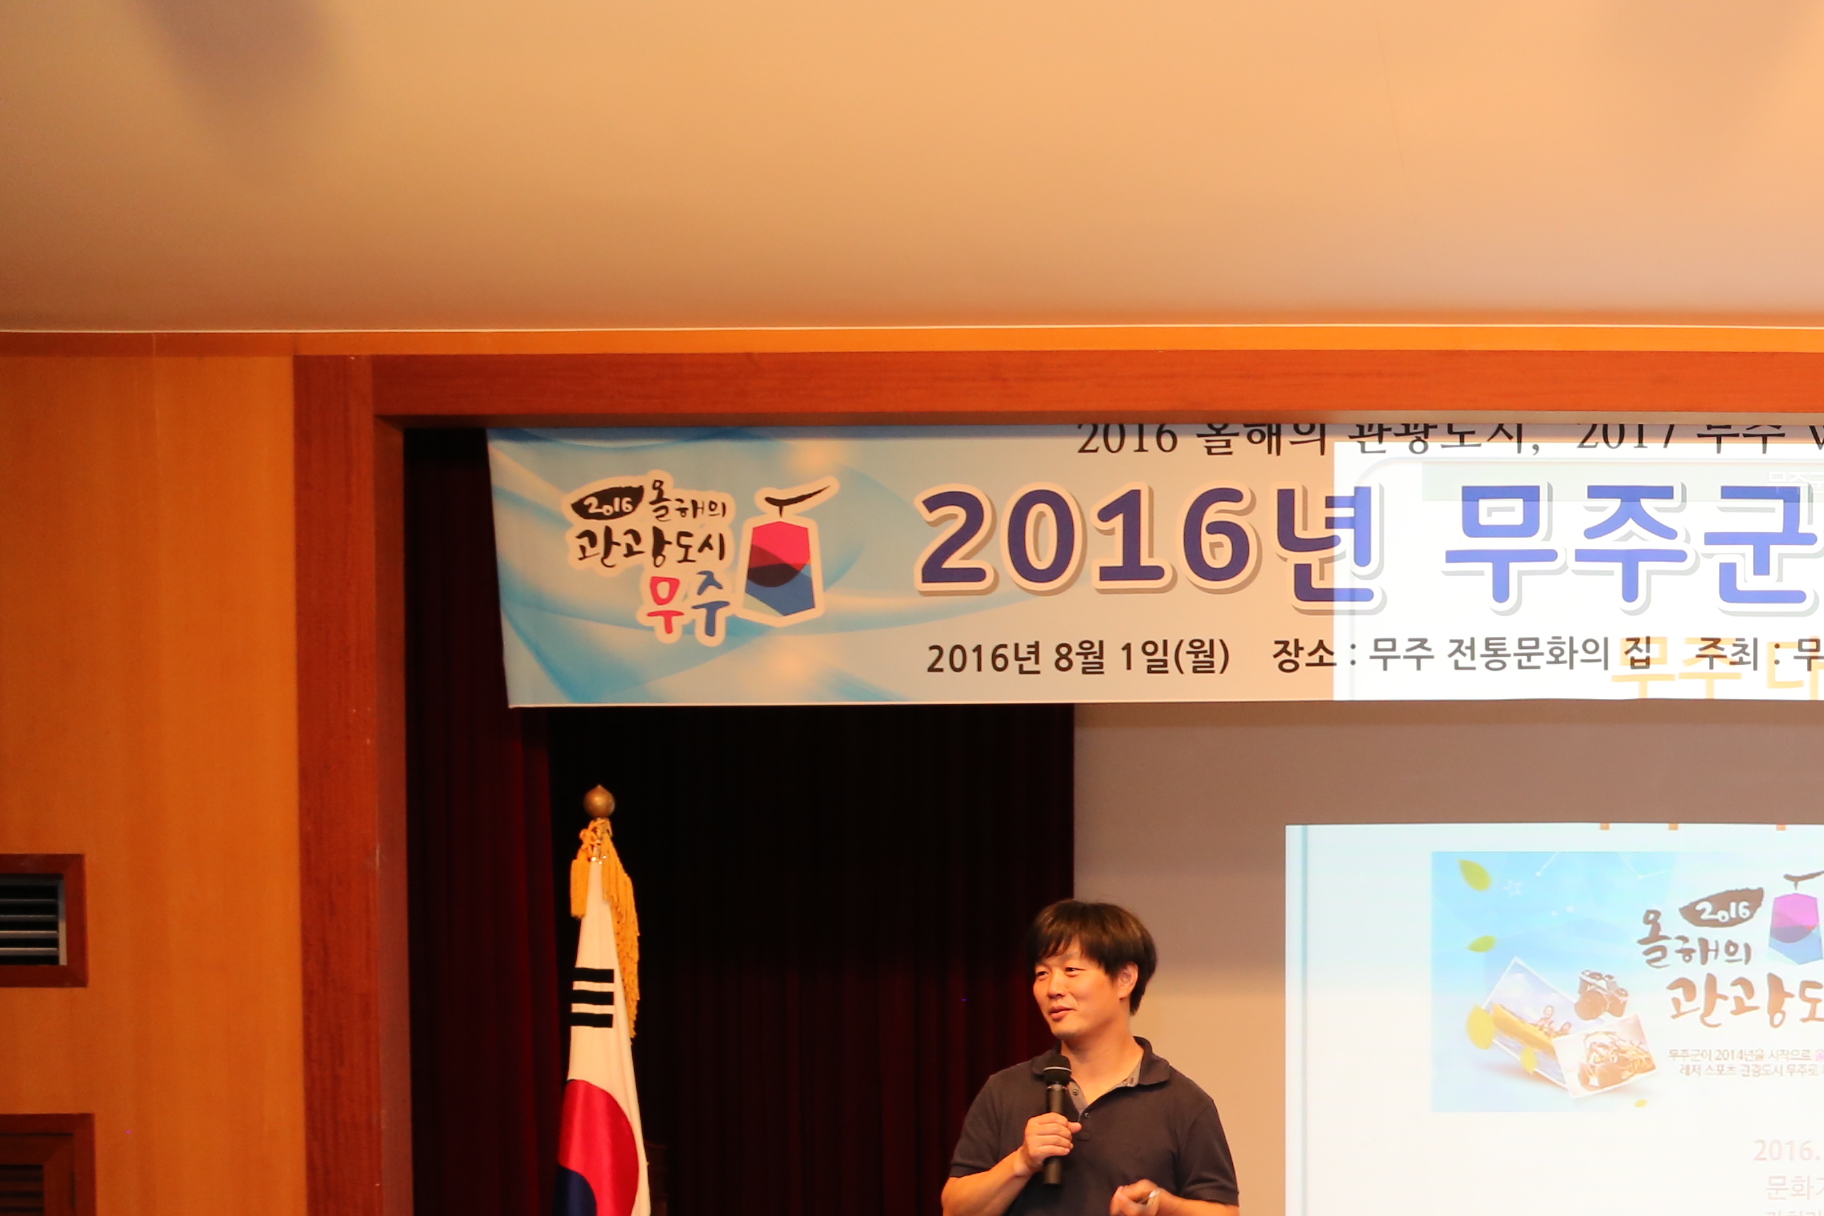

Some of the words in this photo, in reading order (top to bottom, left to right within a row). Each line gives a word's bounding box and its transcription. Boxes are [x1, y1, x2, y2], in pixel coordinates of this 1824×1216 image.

[1077, 423, 1178, 454] 2016
[1196, 423, 1326, 456] 올해의
[583, 496, 633, 516] 2016
[649, 479, 726, 522] 올해의
[575, 525, 725, 568] 관광도시
[920, 485, 1373, 603] 2016년
[646, 570, 730, 637] 무주
[927, 643, 1041, 676] 2016년
[1055, 642, 1106, 676] 8월
[1120, 639, 1230, 676] 1일(월)
[1272, 637, 1337, 674] 장소
[1369, 638, 1435, 673] 무주
[1447, 637, 1611, 672] 전통문화의
[1625, 636, 1652, 670] 집
[1695, 636, 1759, 671] 주최
[1695, 901, 1751, 924] 2016
[1636, 909, 1752, 968] 올해의
[1753, 1139, 1821, 1162] 2016.
